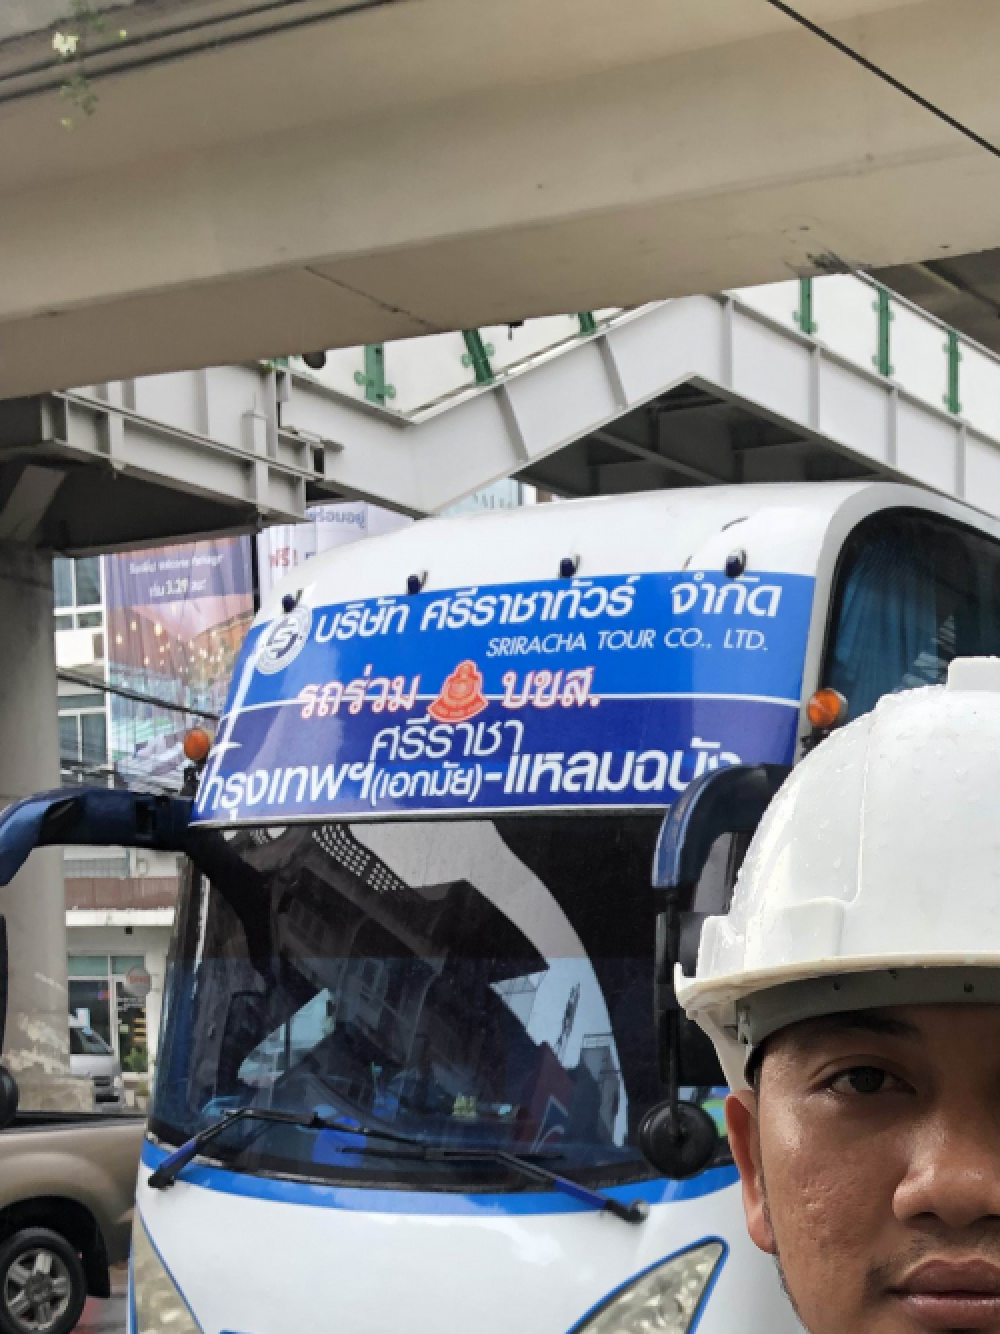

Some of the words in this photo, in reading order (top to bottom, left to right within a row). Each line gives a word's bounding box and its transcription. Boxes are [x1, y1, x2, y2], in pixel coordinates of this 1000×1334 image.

[315, 596, 410, 643] บริษัท
[419, 574, 641, 631] ศรีราชาทัวร์
[671, 571, 783, 618] จำกัด
[485, 632, 587, 658] SRIRACHA
[598, 629, 656, 651] TOUR
[664, 627, 712, 650] CO.,
[723, 629, 768, 651] LTD.
[296, 663, 421, 719] รถร่วม
[501, 666, 601, 708] บขส.
[369, 713, 525, 761] ศรีราชา
